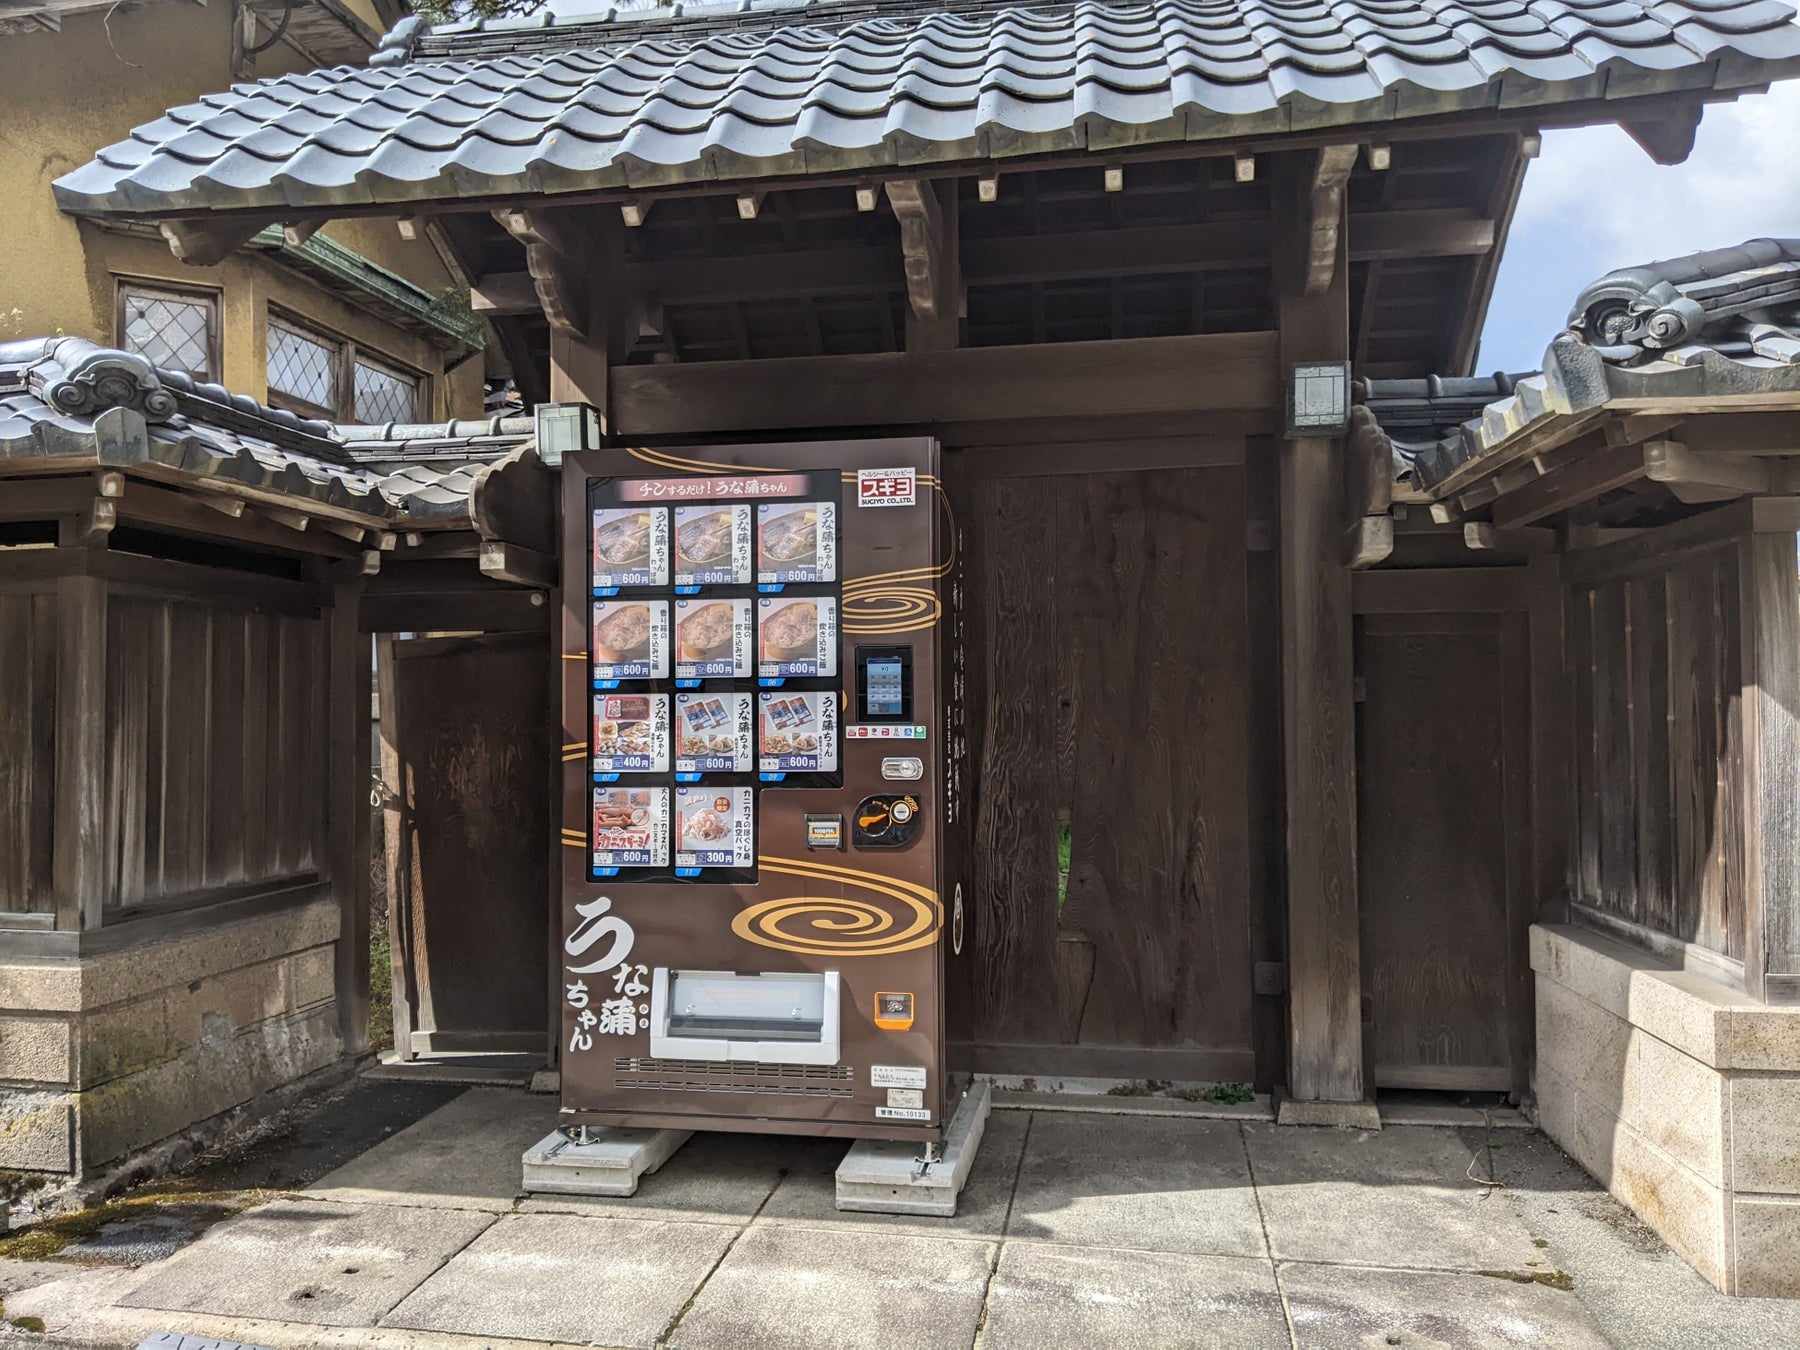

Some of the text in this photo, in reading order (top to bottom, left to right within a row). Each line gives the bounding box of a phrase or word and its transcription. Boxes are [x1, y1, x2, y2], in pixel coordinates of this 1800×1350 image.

[862, 478, 911, 497] スギヨ
[622, 573, 649, 584] 600円
[704, 572, 731, 583] 600円
[788, 570, 816, 581] 600円
[623, 664, 649, 675] 600円
[706, 663, 732, 674] 600円
[789, 663, 816, 673] 600円
[655, 698, 666, 758] うな蒲ちゃん
[738, 698, 750, 759] うな蒲ちゃん
[822, 696, 834, 757] うな蒲ちゃん
[623, 756, 649, 768] 400円
[706, 758, 732, 769] 600円
[790, 756, 816, 767] 600円
[743, 789, 751, 861] カニカマのほぐし身
[623, 851, 649, 862] 600円
[706, 852, 732, 863] 300円
